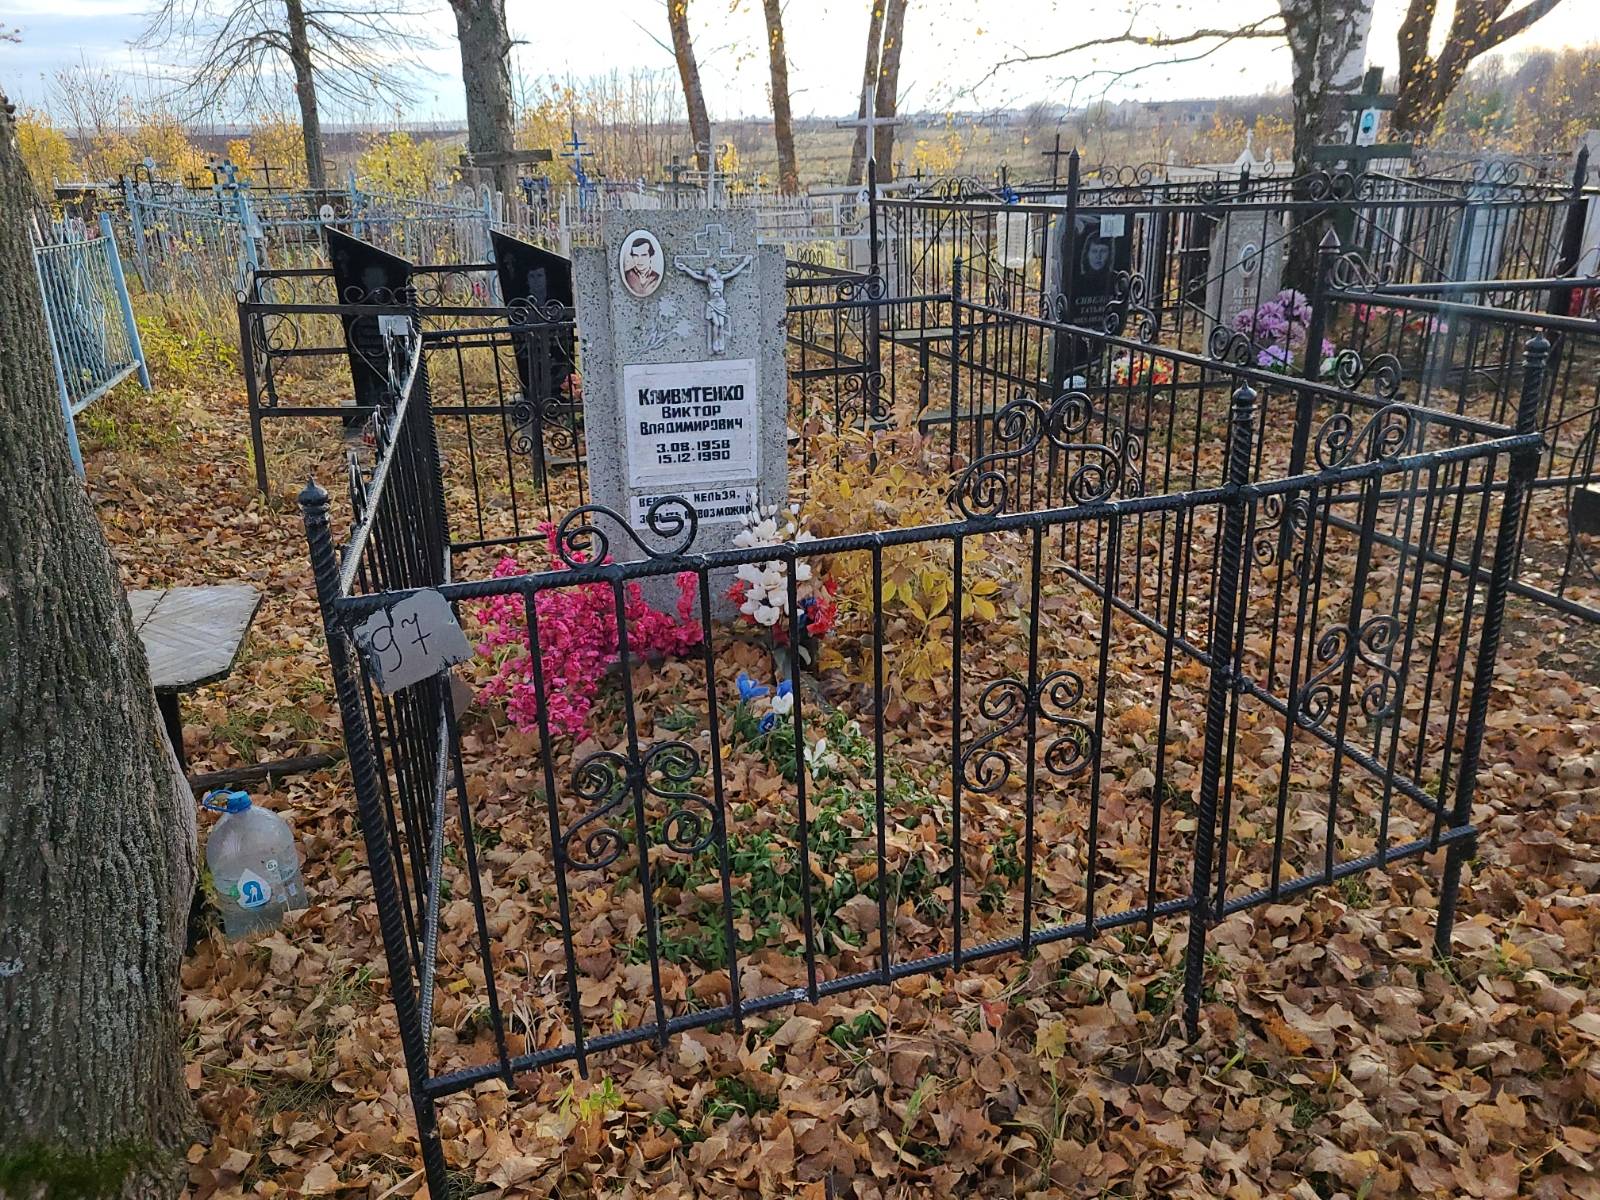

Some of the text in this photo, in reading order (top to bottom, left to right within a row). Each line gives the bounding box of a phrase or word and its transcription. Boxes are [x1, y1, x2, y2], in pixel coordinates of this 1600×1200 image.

[661, 405, 722, 419] ВИКТОР
[640, 417, 743, 436] ВЛАДИМИРОВИЧ
[656, 439, 731, 454] 3.08.1958
[658, 450, 731, 465] 15.12.1990
